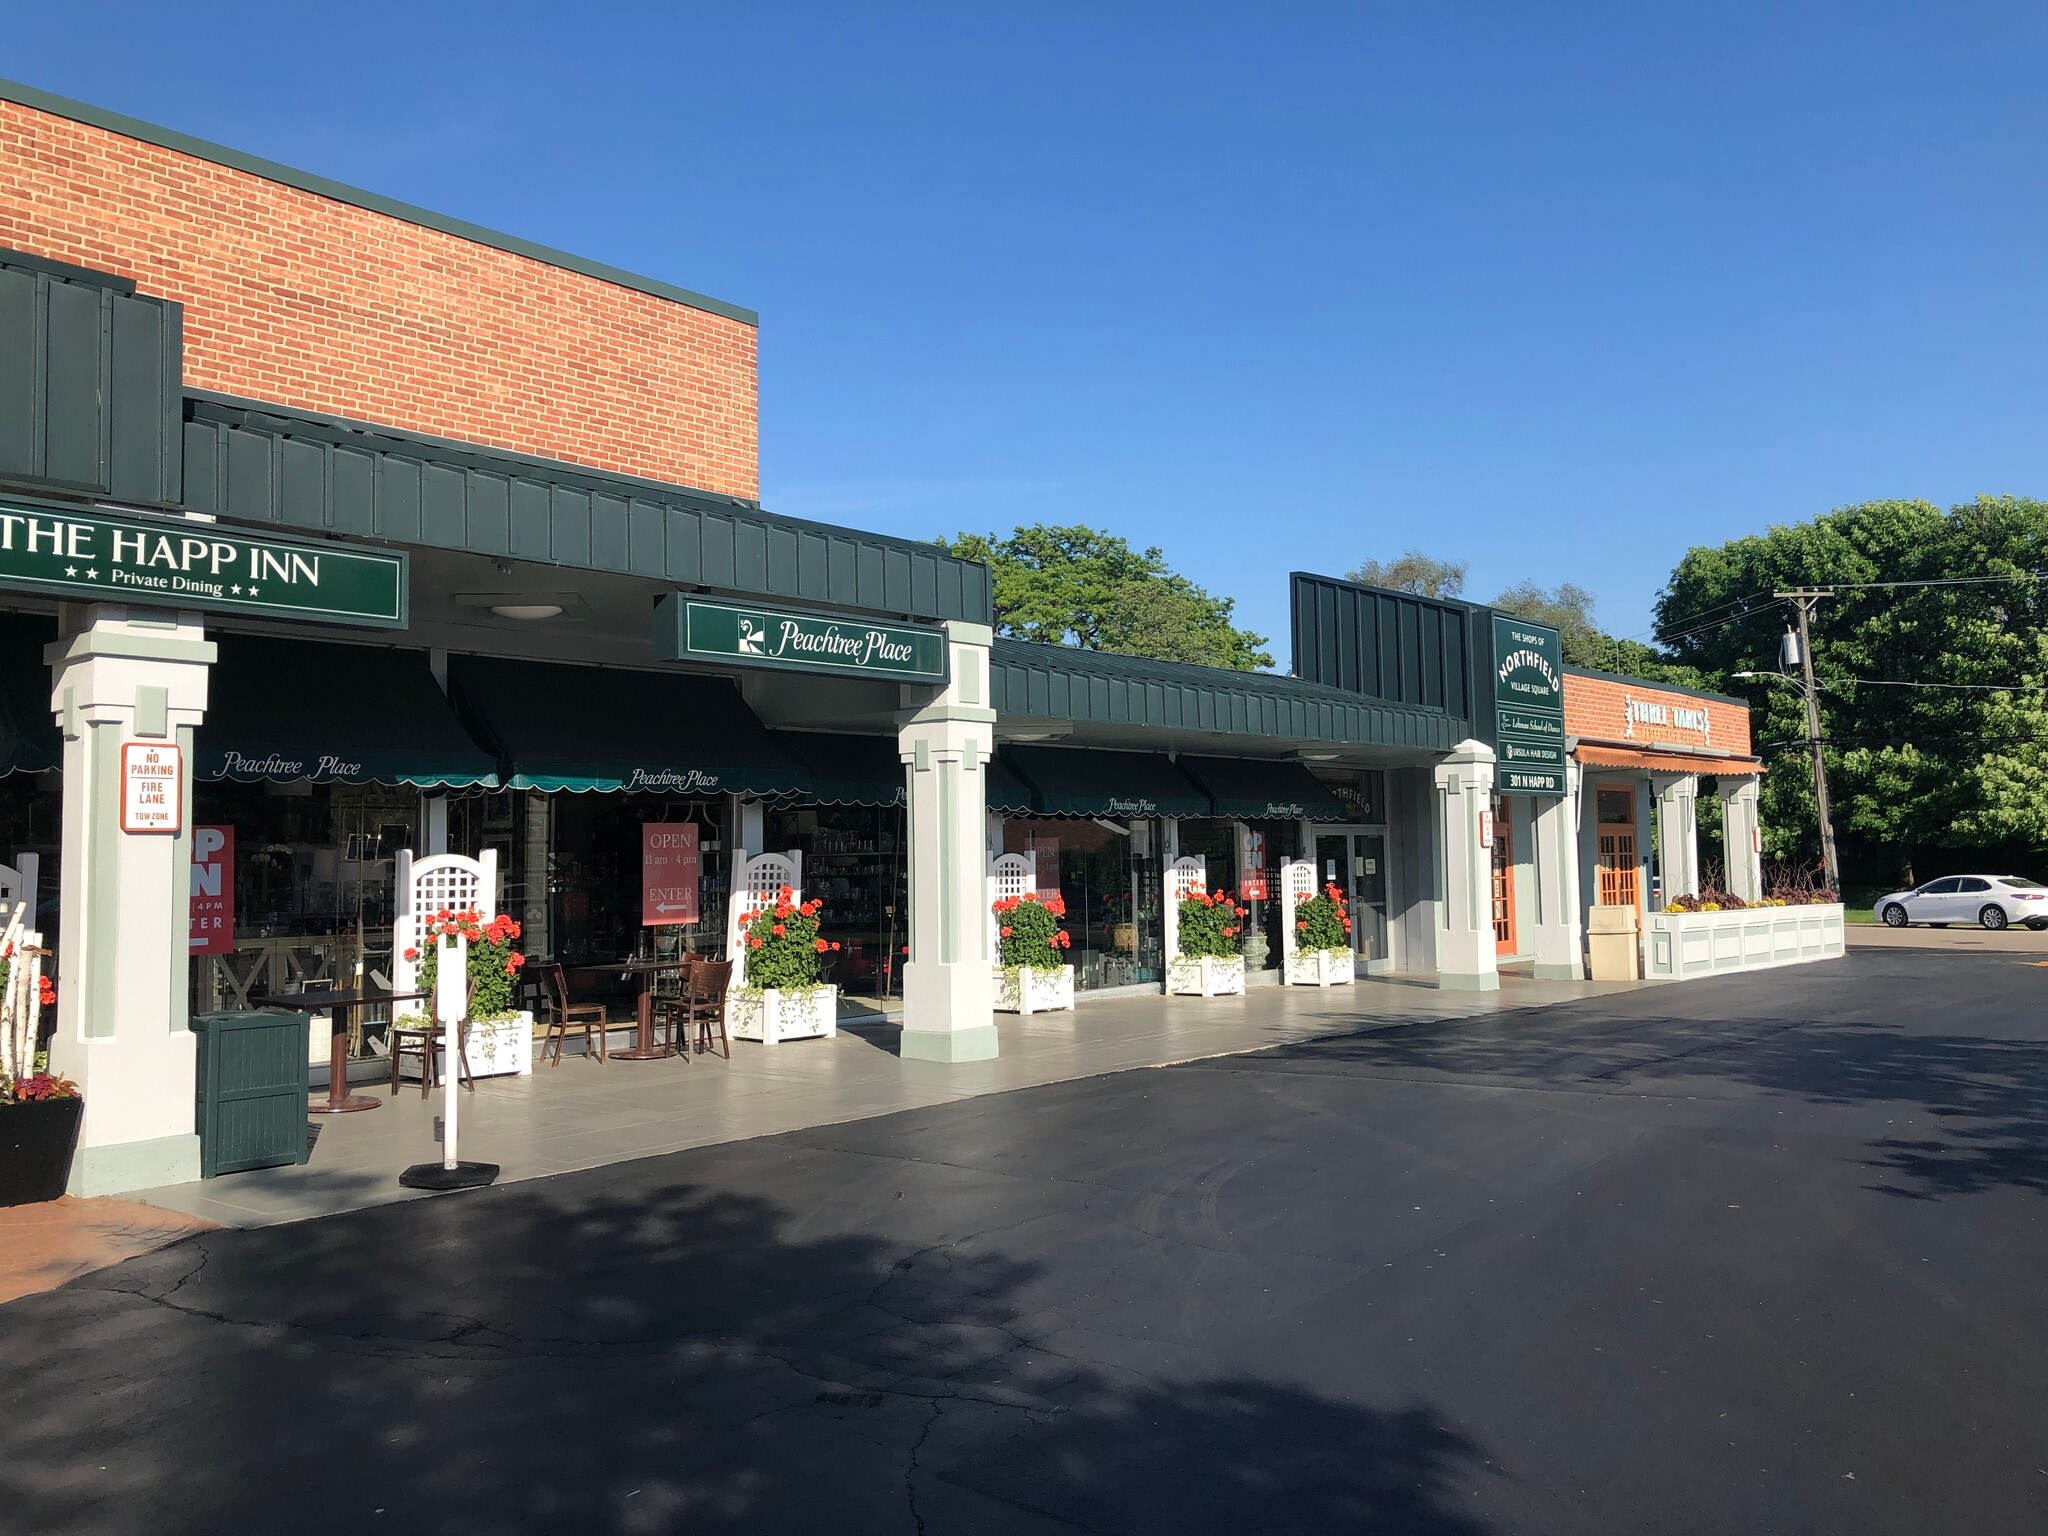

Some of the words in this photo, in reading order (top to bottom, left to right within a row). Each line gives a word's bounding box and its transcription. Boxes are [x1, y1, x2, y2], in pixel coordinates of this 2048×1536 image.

[0, 515, 96, 560] THE
[112, 529, 237, 575] HAPP
[250, 548, 319, 587] INN
[112, 569, 168, 588] Private
[172, 576, 223, 598] Dining
[769, 620, 863, 657] Peachtree
[856, 631, 912, 665] Place
[1511, 631, 1521, 642] THE
[1522, 633, 1538, 646] SHOPS
[1537, 637, 1545, 647] OF
[1498, 649, 1559, 693] NORTHFIELD
[1510, 681, 1531, 693] VILLAGE
[1531, 684, 1550, 696] SQUARE
[146, 753, 159, 764] NO
[1513, 747, 1530, 757] URSULA
[1541, 751, 1557, 760] DESIGN
[131, 764, 174, 775] PARKING
[212, 751, 303, 777] Peachtree
[307, 755, 361, 779] Place
[141, 781, 163, 792] FIRE
[623, 768, 686, 790] Peachtree
[679, 769, 719, 790] Place
[1510, 774, 1521, 787] 301
[1522, 775, 1528, 787] N
[1528, 775, 1545, 788] HAPP
[1545, 776, 1555, 789] RD
[139, 793, 165, 804] LANE
[1105, 797, 1139, 814] Peachtree
[1135, 798, 1157, 815] Place
[1332, 787, 1371, 814] THFIELD
[135, 812, 151, 821] TOW
[151, 812, 169, 821] ZONE
[191, 828, 225, 862] P
[650, 833, 692, 849] OPEN
[1033, 846, 1056, 858] PEN
[654, 856, 668, 865] am
[675, 854, 682, 865] 4
[683, 855, 698, 867] pm
[191, 863, 222, 897] N
[649, 887, 693, 902] ENTER
[198, 902, 223, 911] 4PM
[189, 916, 222, 929] TER
